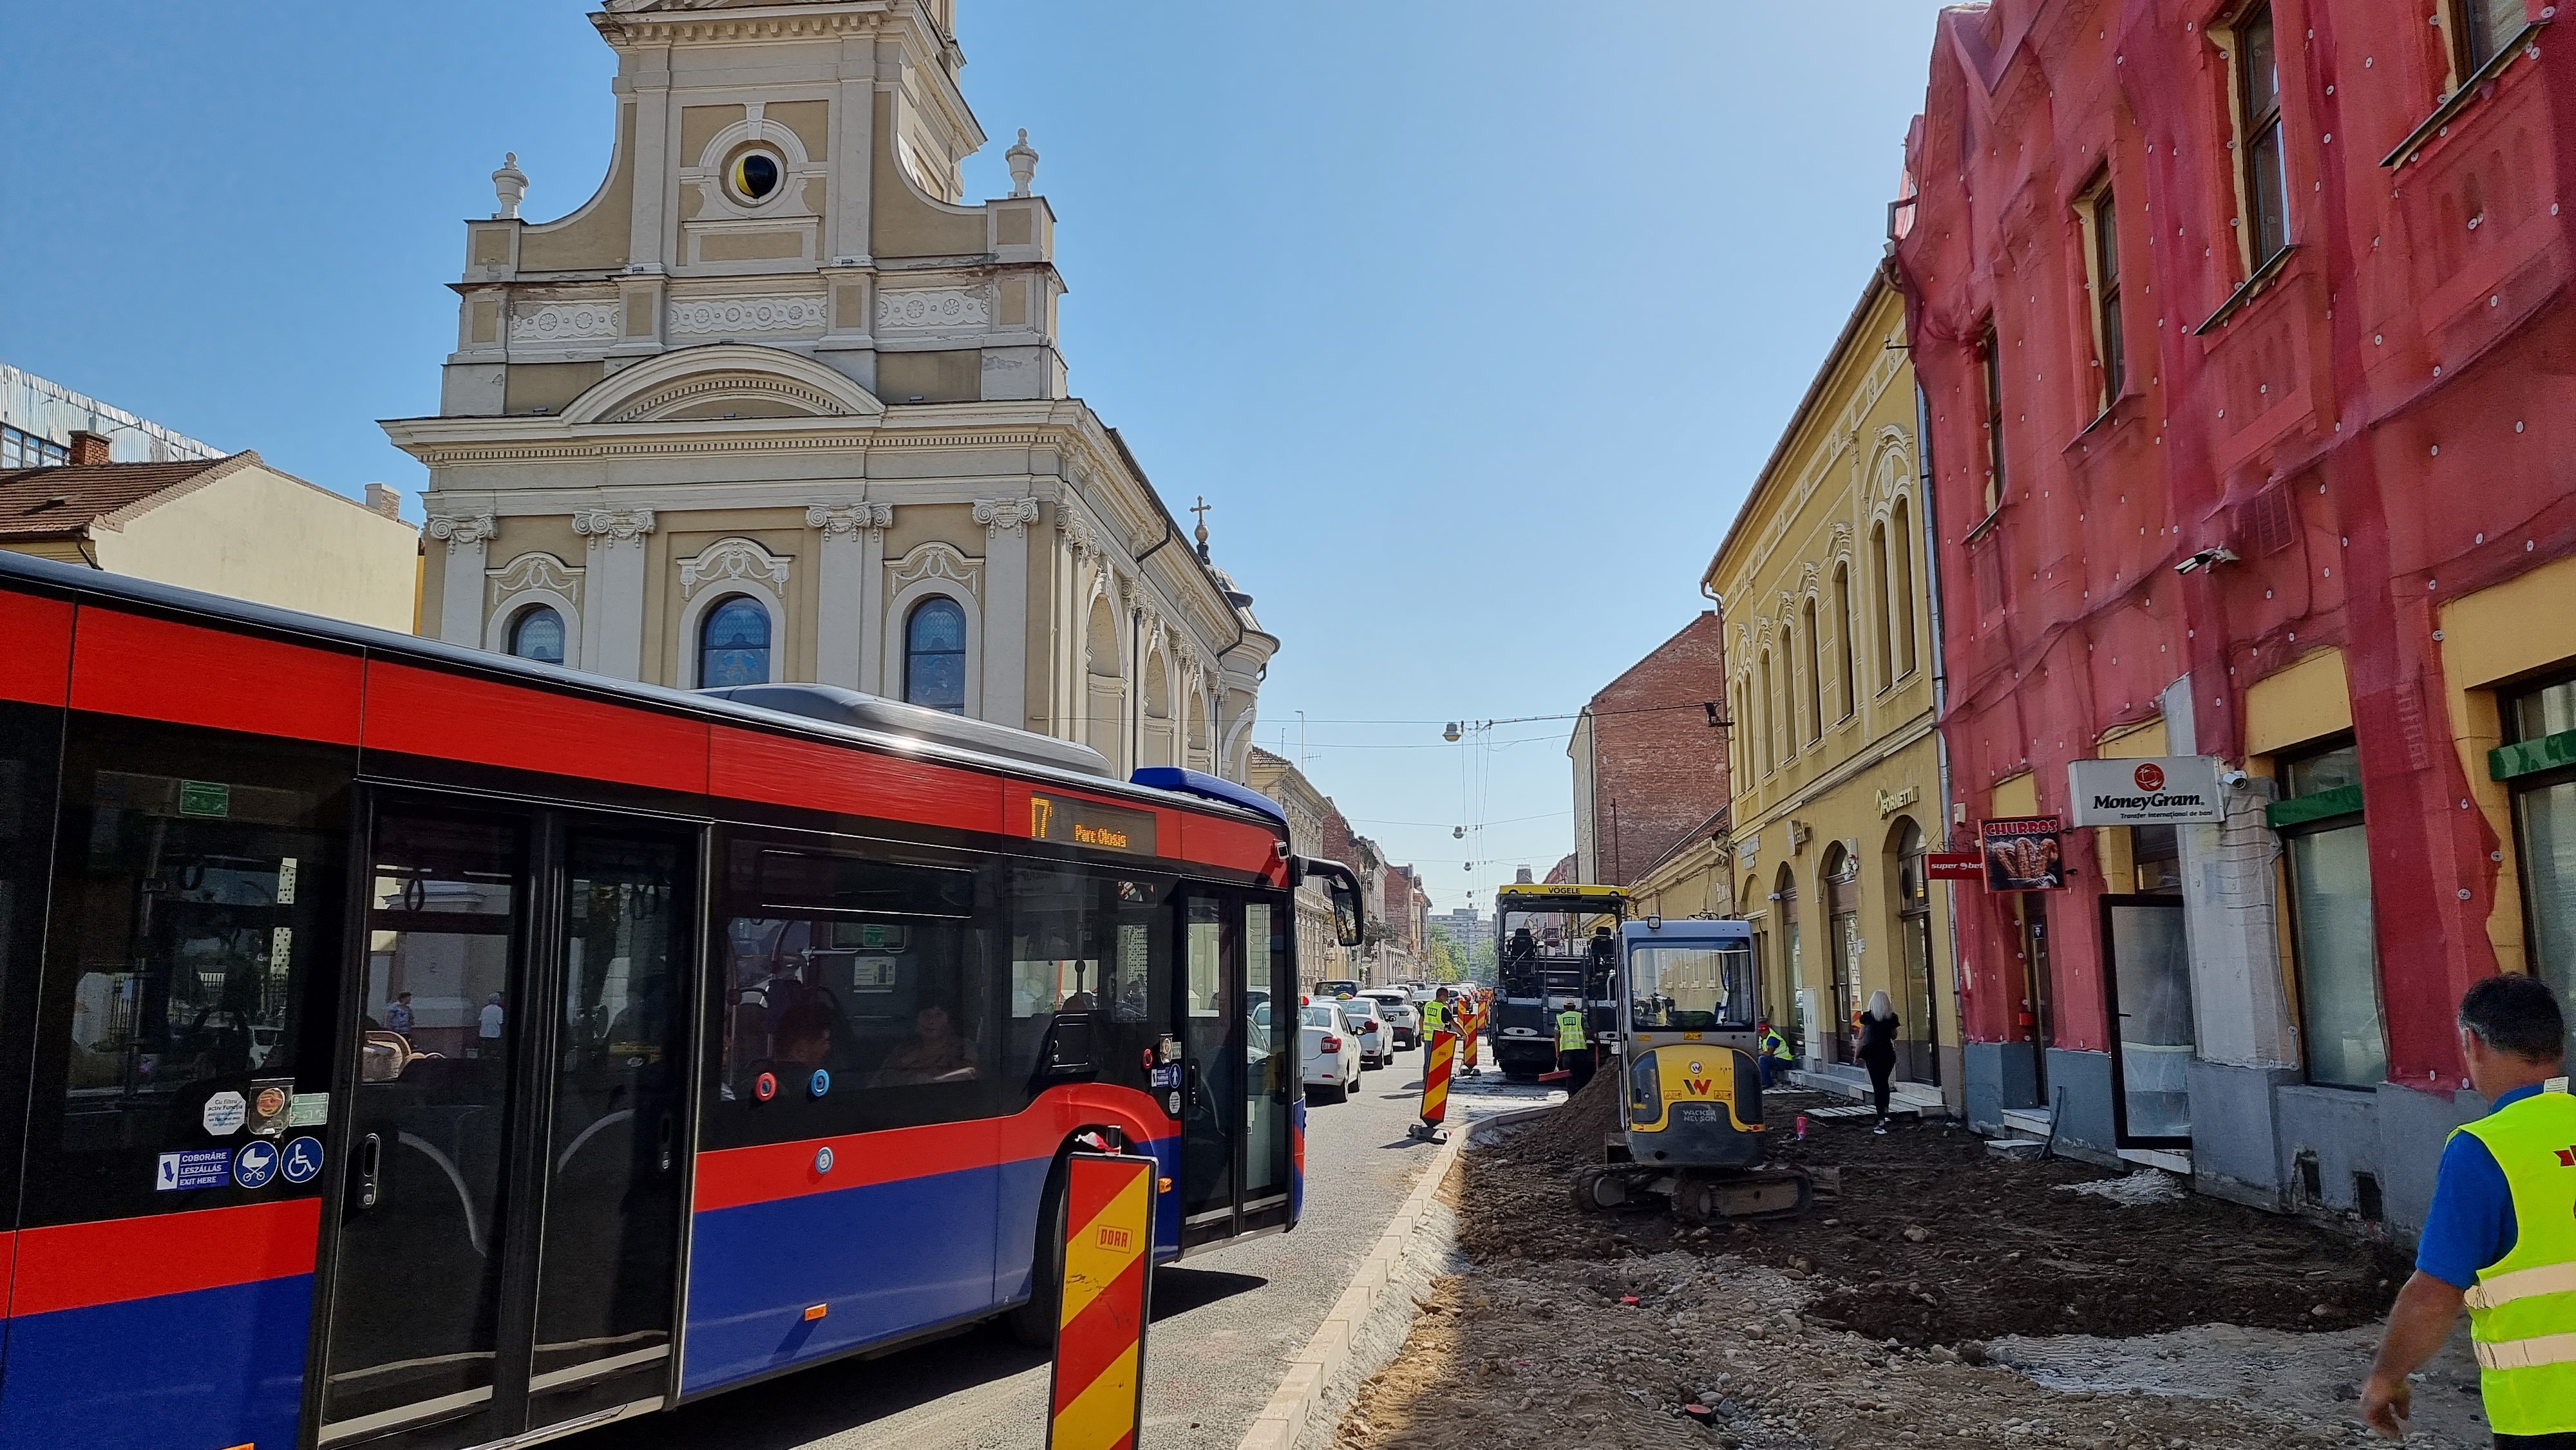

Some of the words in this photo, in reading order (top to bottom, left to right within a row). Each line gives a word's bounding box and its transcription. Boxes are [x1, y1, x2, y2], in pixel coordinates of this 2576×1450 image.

[1985, 820, 2058, 836] CHURROS
[180, 1163, 222, 1175] LESZÁLLÁS
[180, 1178, 196, 1186] EXIT
[196, 1176, 217, 1185] HERE
